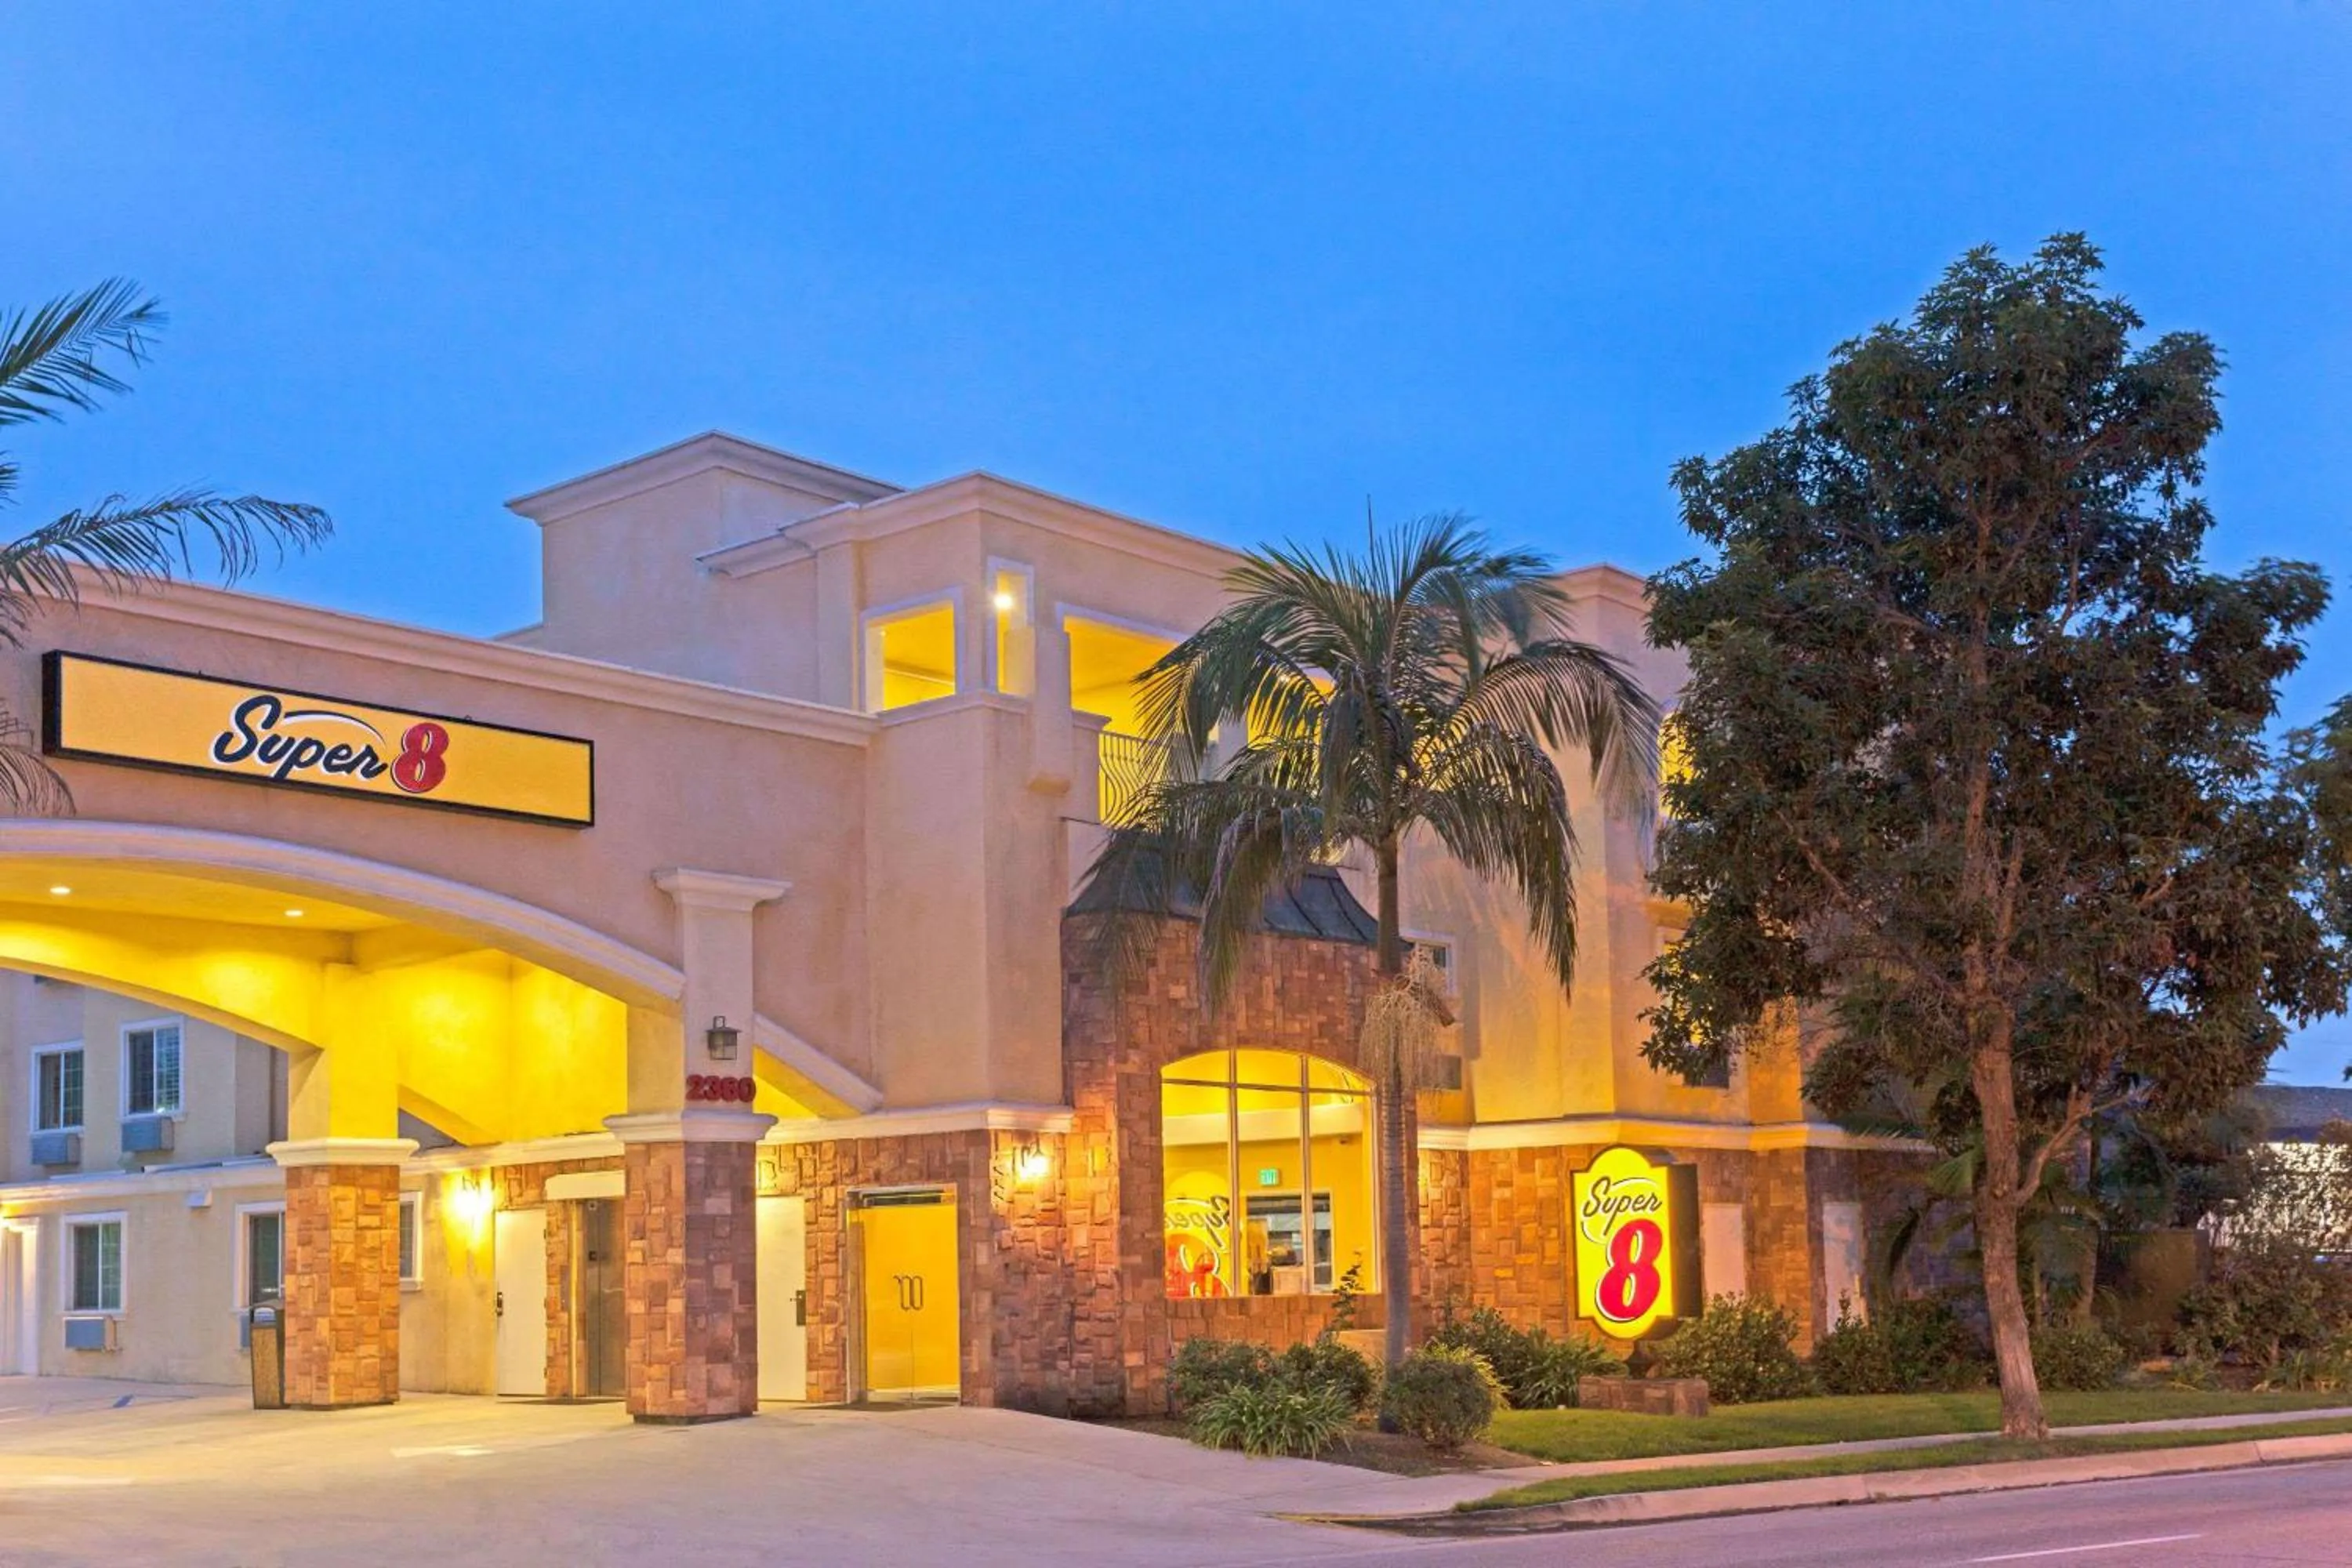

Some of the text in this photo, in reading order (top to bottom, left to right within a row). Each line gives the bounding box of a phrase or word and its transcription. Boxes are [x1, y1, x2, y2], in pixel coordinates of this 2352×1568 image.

[212, 694, 450, 793] Super 8
[1582, 1176, 1663, 1236] Super
[1595, 1218, 1663, 1322] 8
